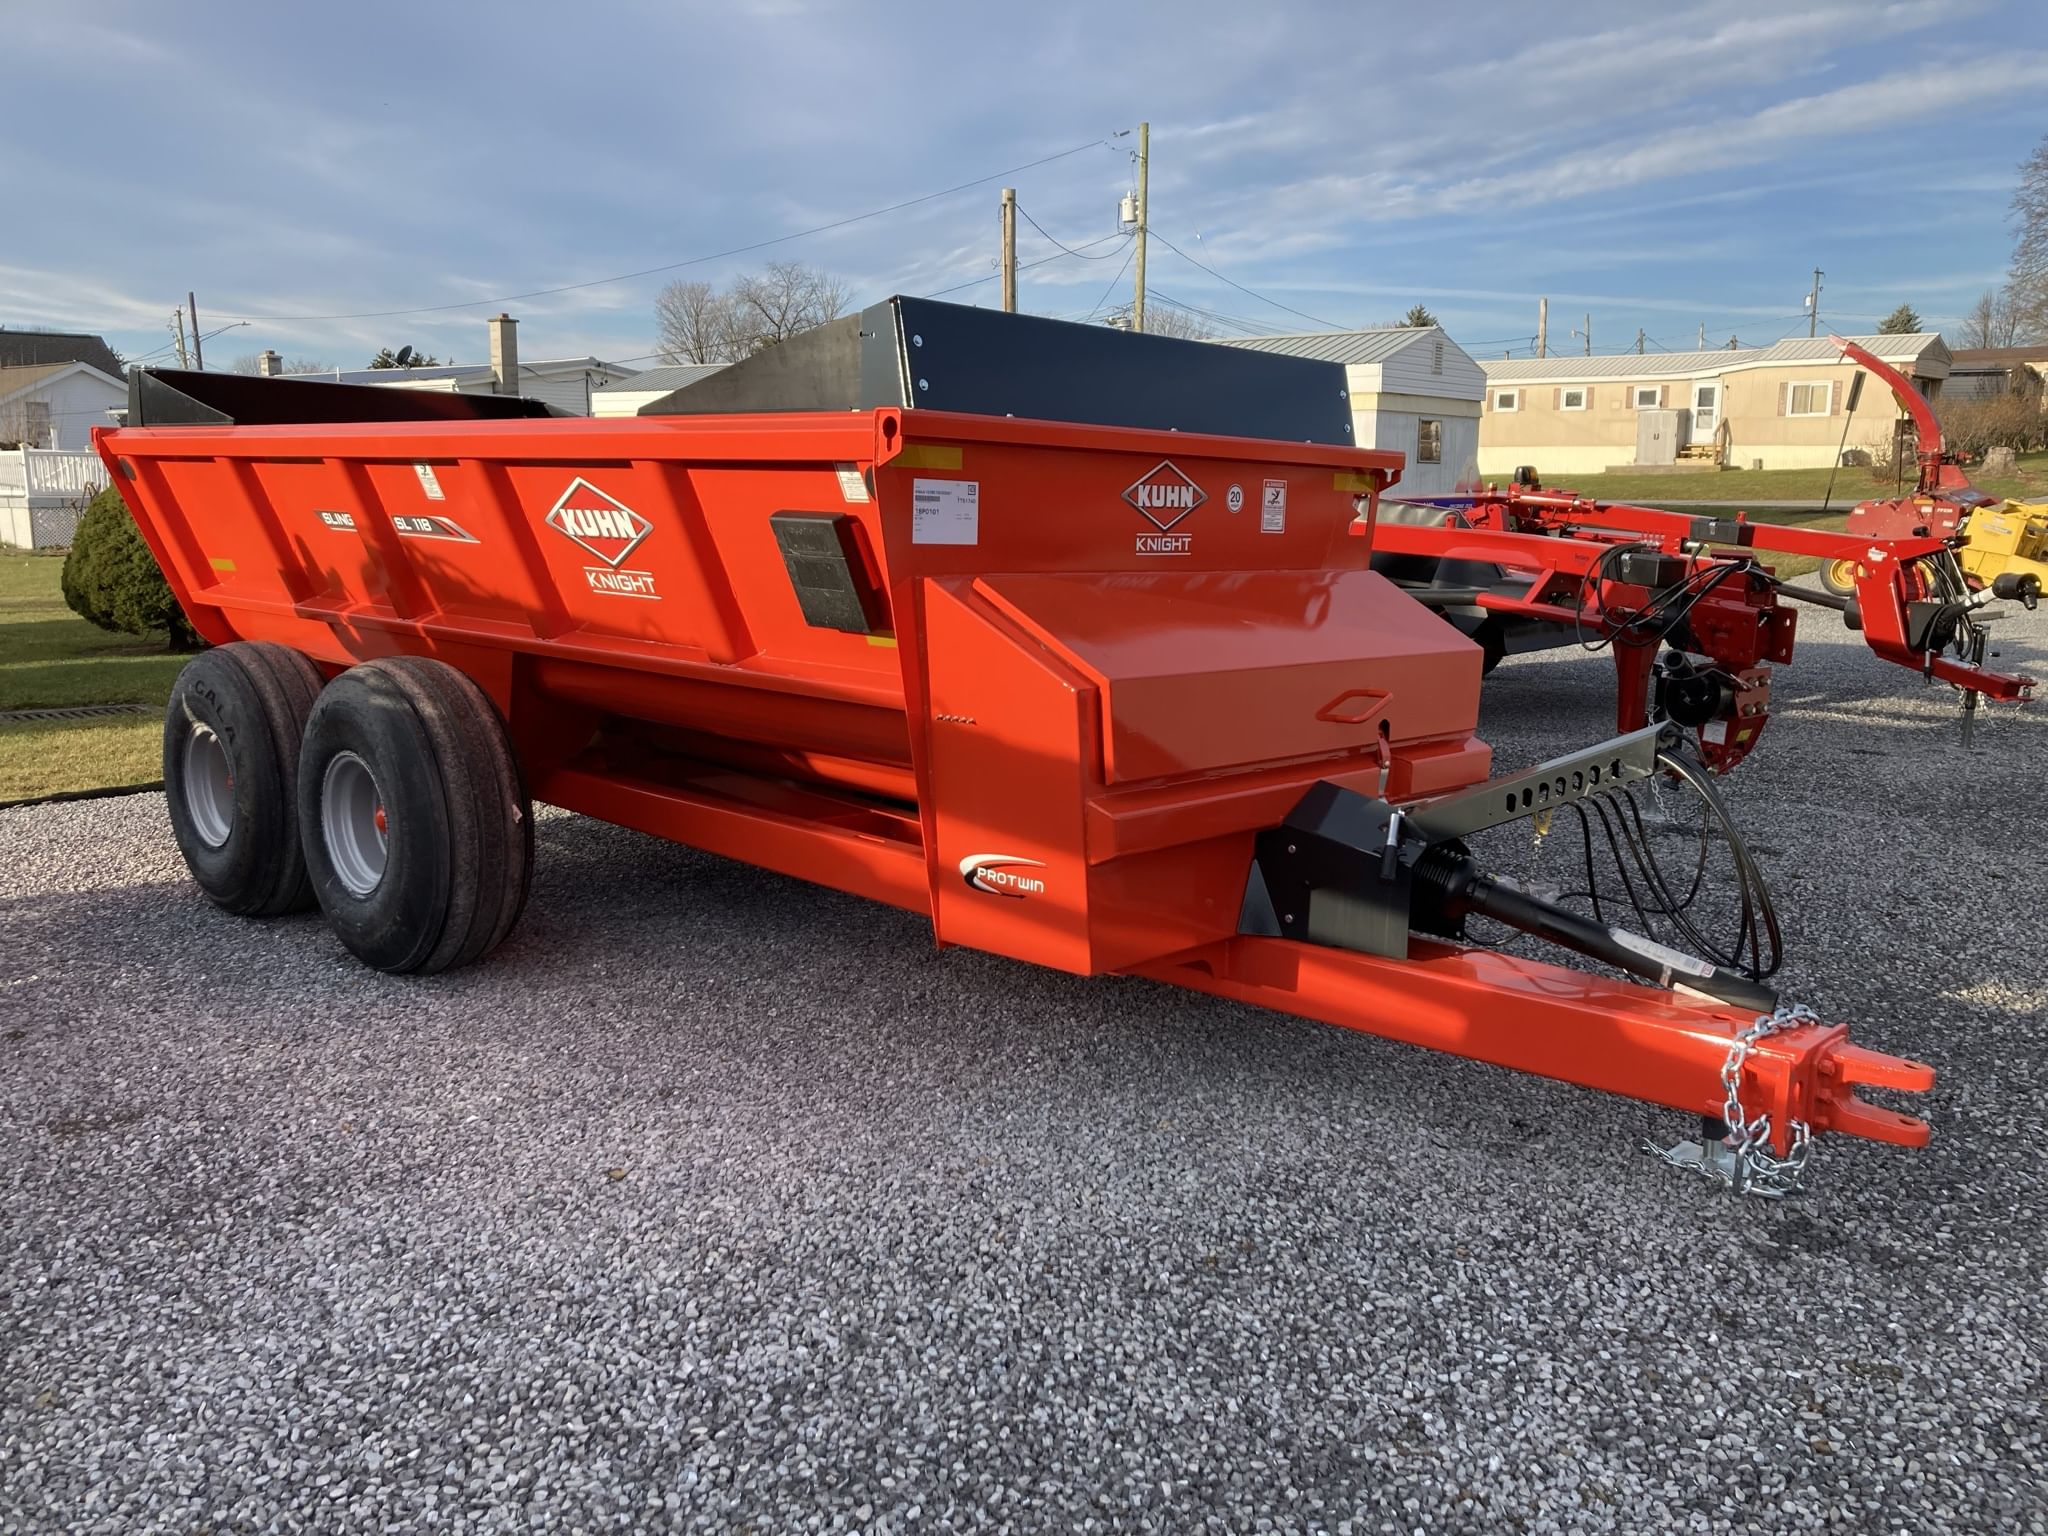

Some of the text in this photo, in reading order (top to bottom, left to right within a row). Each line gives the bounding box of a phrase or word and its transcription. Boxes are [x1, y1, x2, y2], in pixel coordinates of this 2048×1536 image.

[1137, 484, 1194, 508] KUHN
[1230, 491, 1241, 503] 20
[394, 517, 432, 532] SL 118
[559, 508, 638, 539] KUHN
[1136, 537, 1192, 551] KNIGHT
[585, 571, 655, 593] KNIGHT
